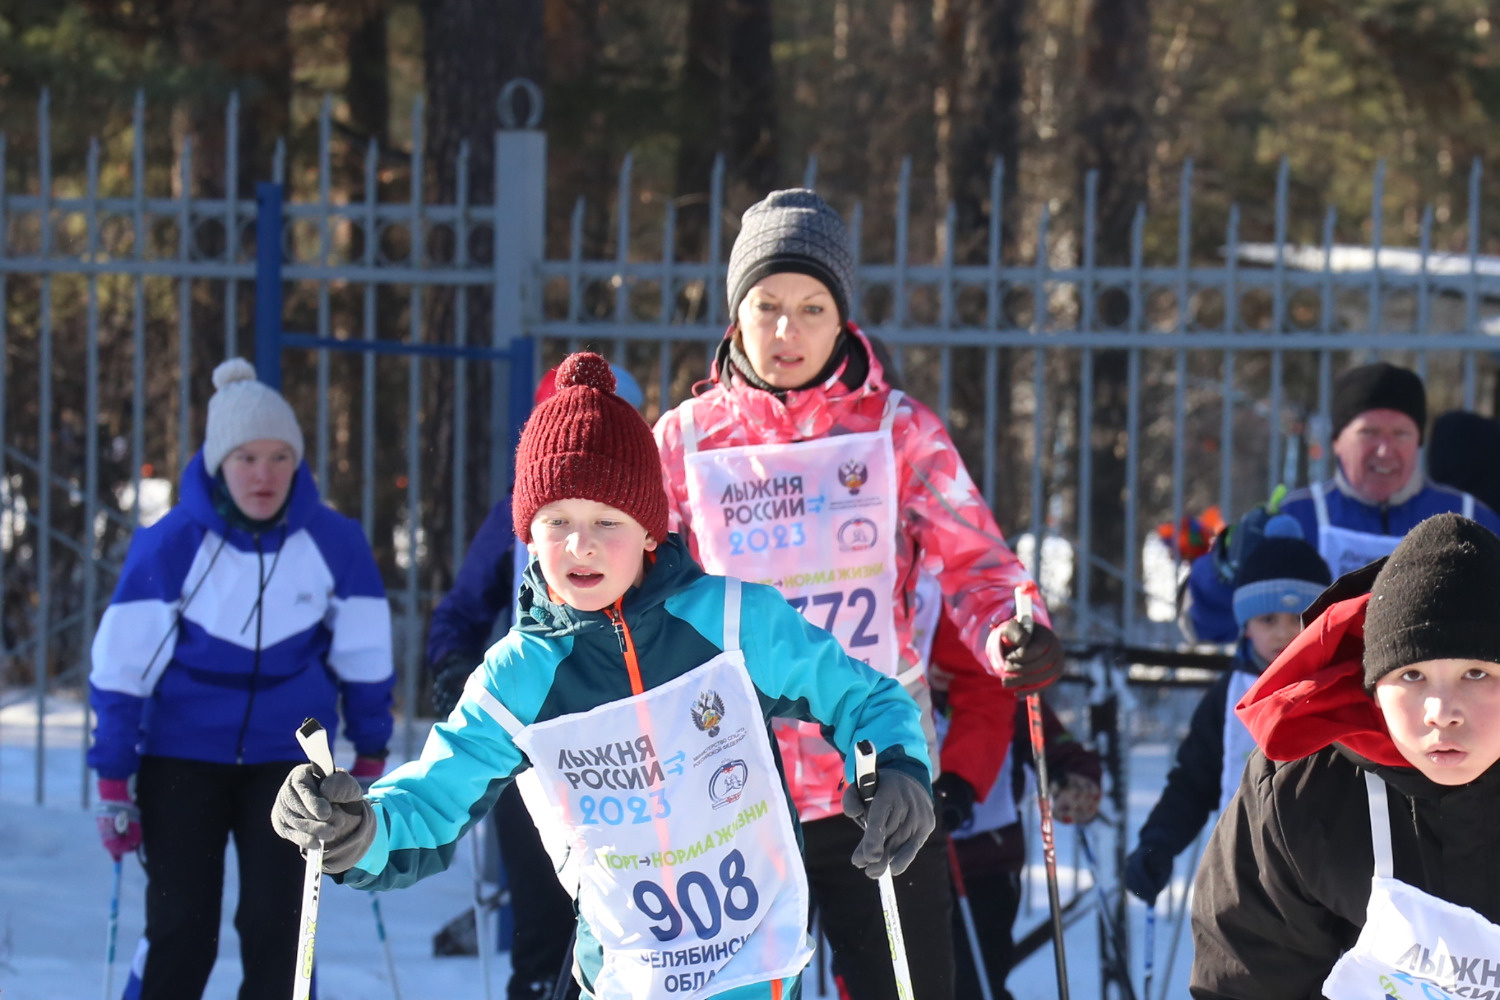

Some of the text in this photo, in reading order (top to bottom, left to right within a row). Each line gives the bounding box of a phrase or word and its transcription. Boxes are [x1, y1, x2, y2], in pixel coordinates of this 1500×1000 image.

[720, 476, 803, 504] ЛЫЖНЯ
[724, 498, 805, 527] РОССИИ
[728, 523, 806, 556] 2023
[785, 571, 834, 589] НОРМА
[838, 563, 884, 581] ЖИЗНИ
[557, 735, 656, 770] ЛЫЖНЯ
[562, 761, 665, 790] РОССИИ
[580, 787, 672, 826] 2023
[651, 834, 716, 868] НОРМА
[633, 849, 759, 941] 908
